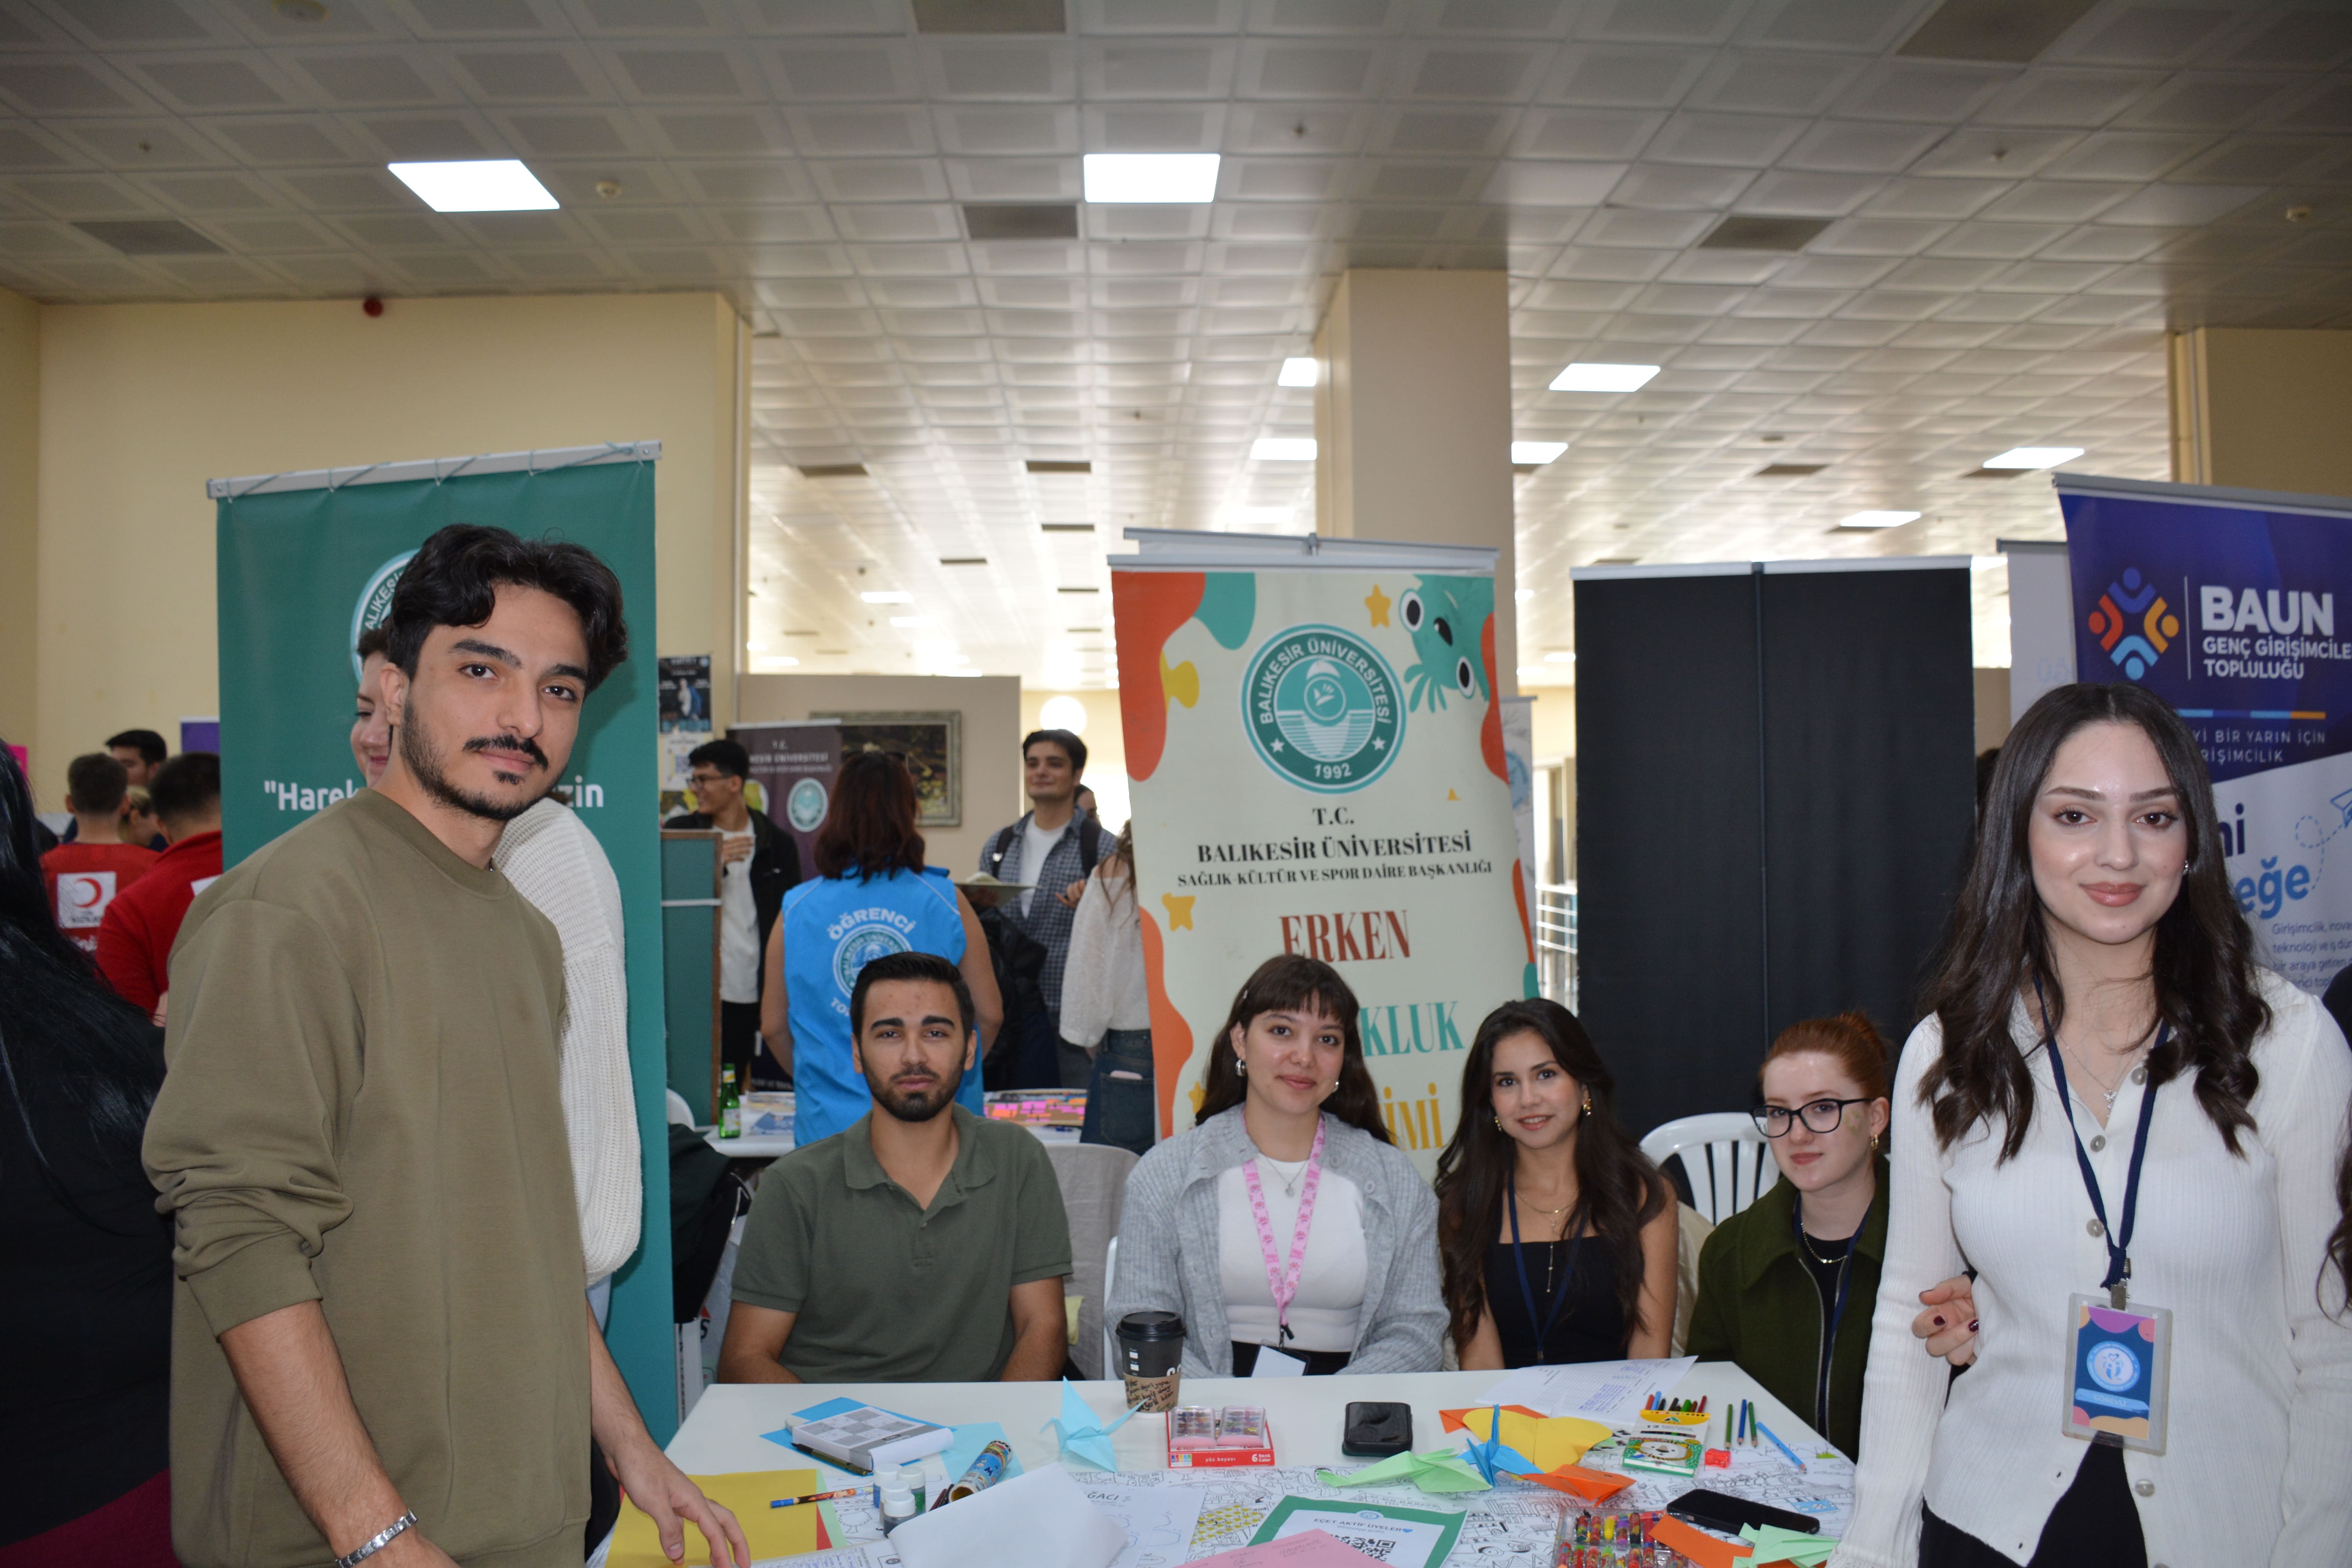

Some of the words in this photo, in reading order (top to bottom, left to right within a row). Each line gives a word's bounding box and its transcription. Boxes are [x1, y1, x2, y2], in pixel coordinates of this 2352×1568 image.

[2200, 585, 2334, 636] BAUN
[2203, 637, 2251, 659] GENÇ
[1258, 644, 1305, 725] BALIKESİR
[1307, 637, 1392, 724] ÜNİVERSİTESİ
[2203, 658, 2304, 679] TOPLULUĞU
[2193, 727, 2207, 743] Yİ
[2215, 727, 2240, 744] BİR
[2246, 730, 2291, 744] YARIN
[2298, 728, 2325, 747] İÇİN
[1314, 762, 1352, 779] 1992
[2201, 747, 2283, 766] RİŞİMCİLİK
[553, 774, 604, 808] zin
[1312, 807, 1355, 826] T.C.
[2218, 802, 2245, 857] ni
[1197, 837, 1316, 863] BALIKESİR
[1322, 829, 1472, 859] ÜNİVERSİTESİ
[1300, 869, 1319, 883] VE
[1321, 867, 1359, 881] SPOR
[1363, 862, 1406, 879] DAİRE
[1410, 860, 1492, 880] BAŞKANLIĞI
[2235, 856, 2310, 920] eğe
[827, 907, 916, 941] ÖĞRENCİ
[1279, 909, 1411, 963] ERKEN
[1359, 1001, 1465, 1058] KLUK
[1378, 1082, 1444, 1151] İMİ
[1251, 1454, 1258, 1463] 6
[1367, 1523, 1402, 1532] ÜYELER
